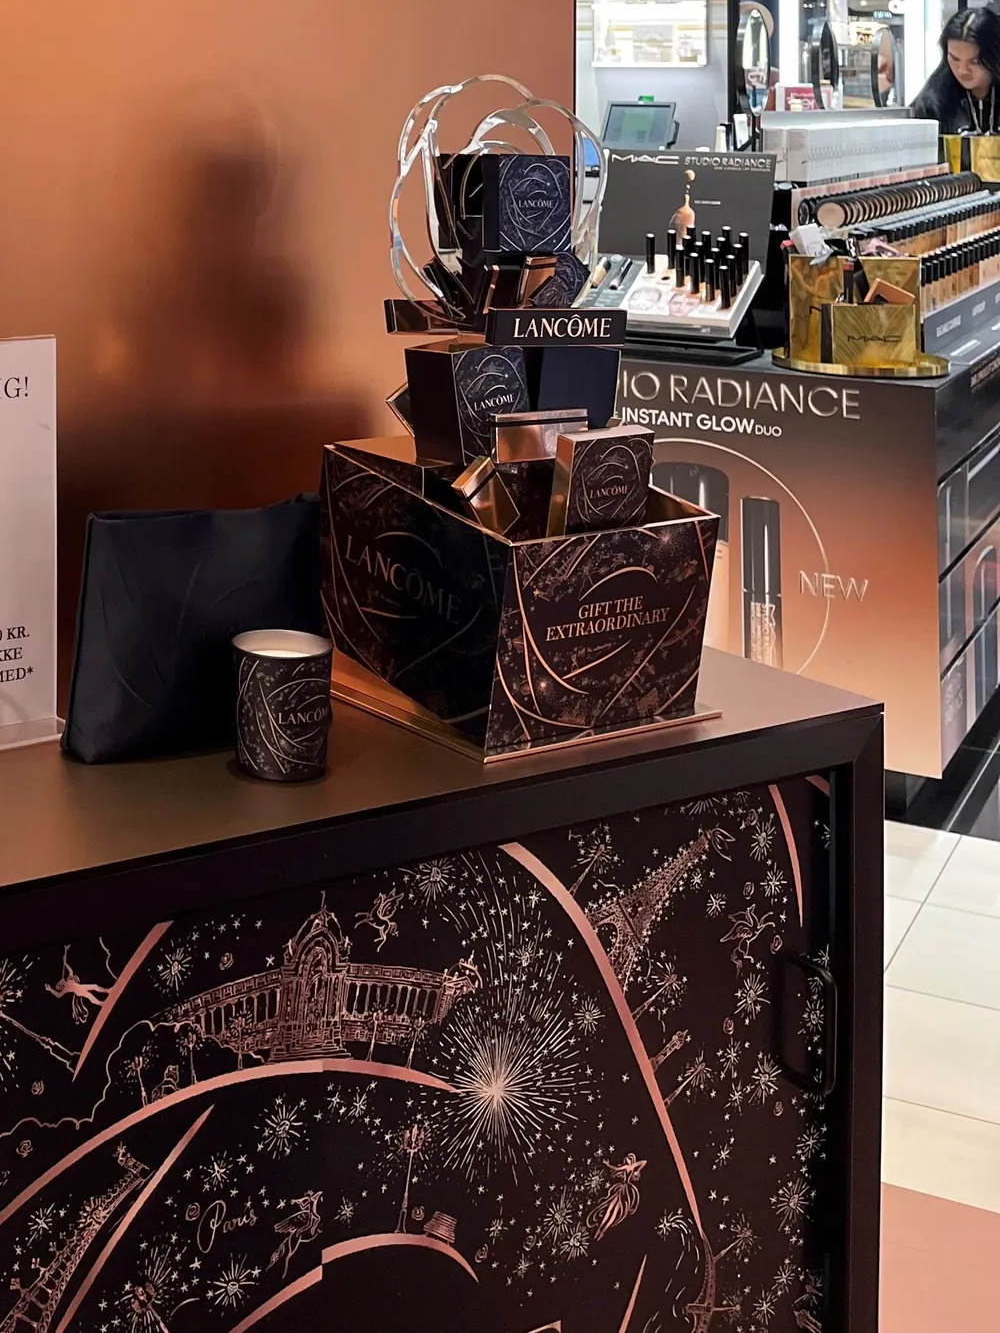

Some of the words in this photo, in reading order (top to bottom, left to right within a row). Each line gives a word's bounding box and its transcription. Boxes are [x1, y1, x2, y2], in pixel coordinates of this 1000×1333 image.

[684, 156, 721, 166] STUDIO
[722, 157, 772, 169] RADIANCE
[518, 198, 554, 209] LANCÔME
[513, 313, 612, 338] LANCÔME
[473, 393, 516, 412] LANCÔME
[670, 373, 861, 420] RADIANCE
[622, 406, 693, 429] INSTANT
[345, 534, 461, 625] LANCÔME
[799, 570, 869, 603] NEW
[578, 600, 613, 620] GIFT
[614, 595, 643, 615] THE
[6, 625, 31, 640] KR.
[544, 607, 671, 642] EXTRAORDINARY
[197, 1199, 258, 1254] Paris
